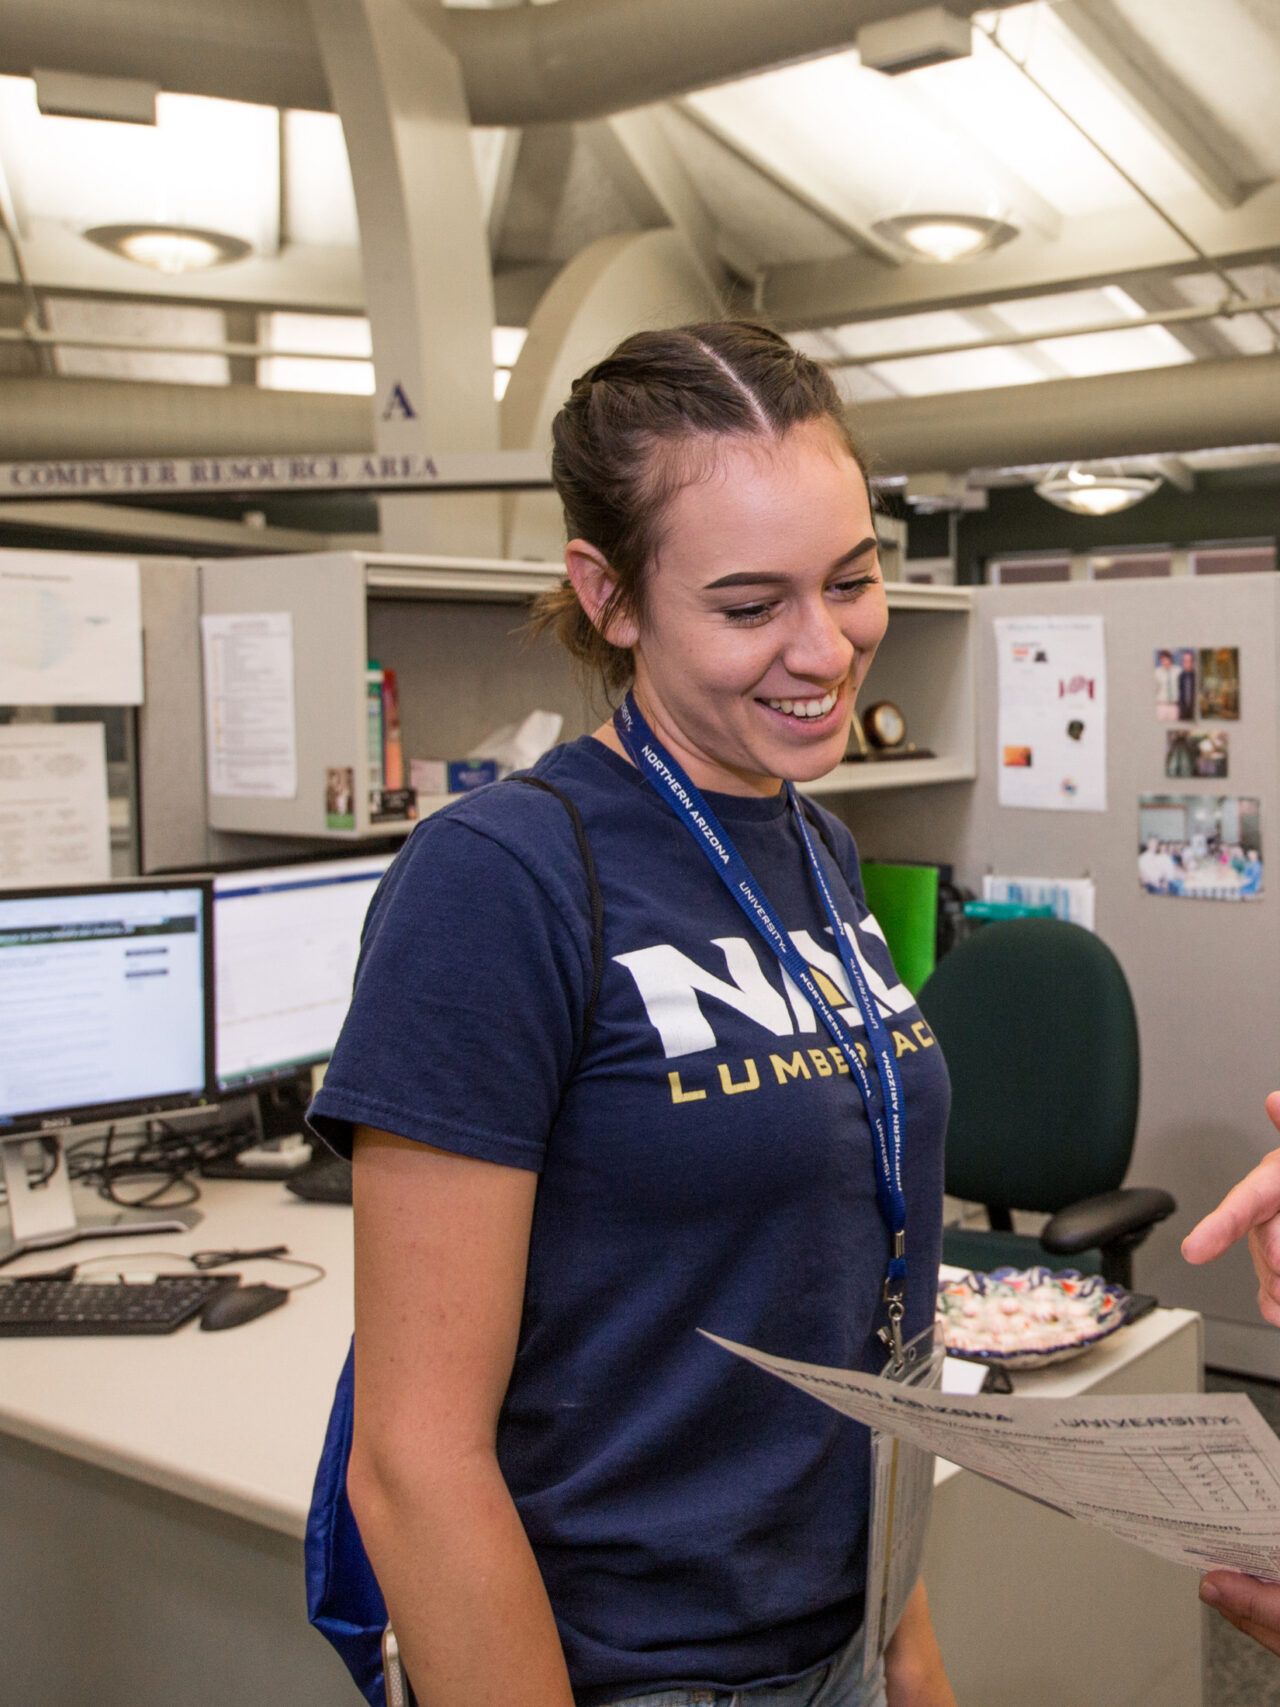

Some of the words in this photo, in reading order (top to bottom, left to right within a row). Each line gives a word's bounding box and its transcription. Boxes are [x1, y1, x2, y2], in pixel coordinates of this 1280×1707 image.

[382, 382, 417, 421] A
[10, 459, 178, 486] COMPUTER
[189, 456, 347, 484] RESOURCE
[361, 456, 439, 480] AREA
[641, 744, 694, 810] NORTHERN
[690, 810, 731, 865] ARIZONA
[739, 881, 788, 954] UNIVERSITY
[799, 971, 845, 1041] NORTHERN
[842, 1041, 872, 1099] ARIZONA
[880, 1049, 900, 1113] ARIZONA
[891, 1112, 903, 1192] NORTHERN
[1057, 1414, 1232, 1430] UNIVERSITY
